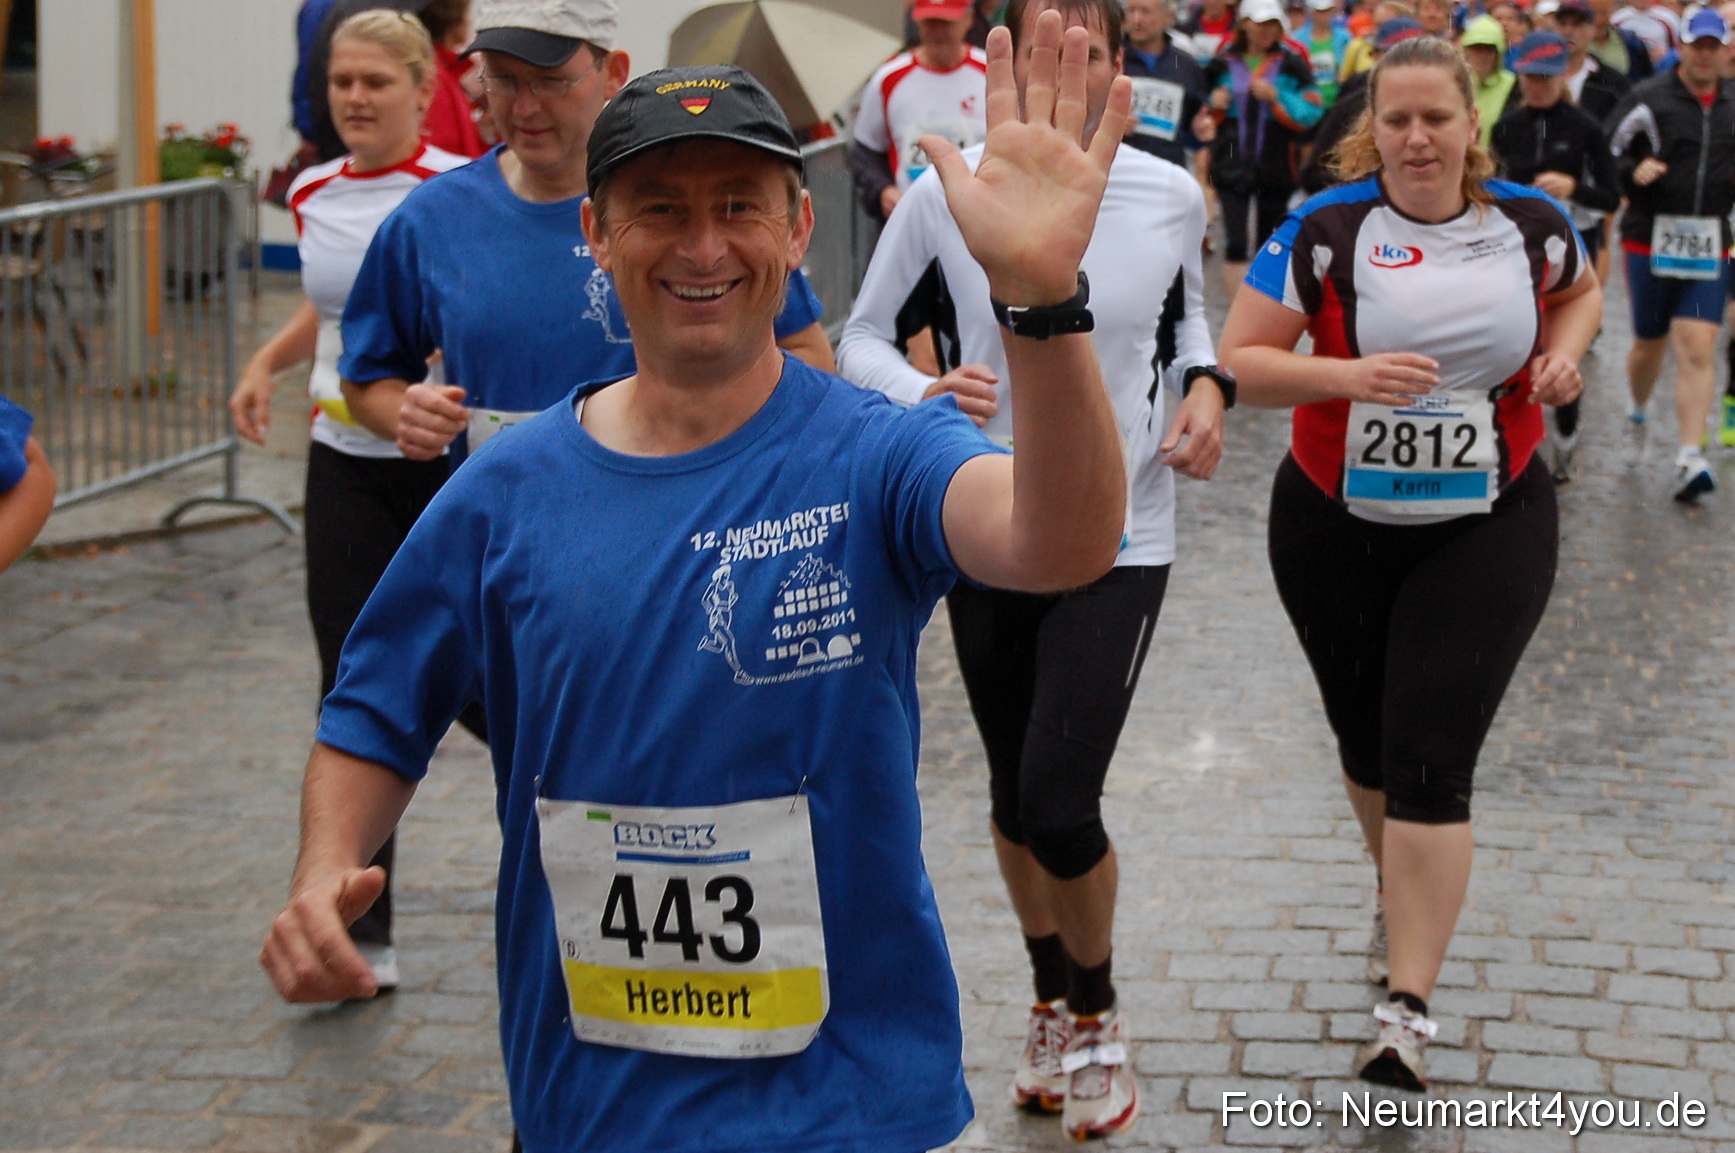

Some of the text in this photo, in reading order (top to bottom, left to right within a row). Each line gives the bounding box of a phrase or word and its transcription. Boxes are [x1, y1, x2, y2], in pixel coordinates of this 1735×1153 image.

[655, 79, 731, 95] GERMANY
[1373, 244, 1408, 260] tkn
[1361, 419, 1477, 468] 2812
[1393, 479, 1441, 496] Karin
[691, 531, 722, 551] 12.
[719, 525, 829, 565] STADTLAUF
[772, 607, 856, 640] 18.09.2011
[613, 821, 716, 849] BOCK
[600, 873, 761, 963] 443
[626, 980, 751, 1019] Herbert
